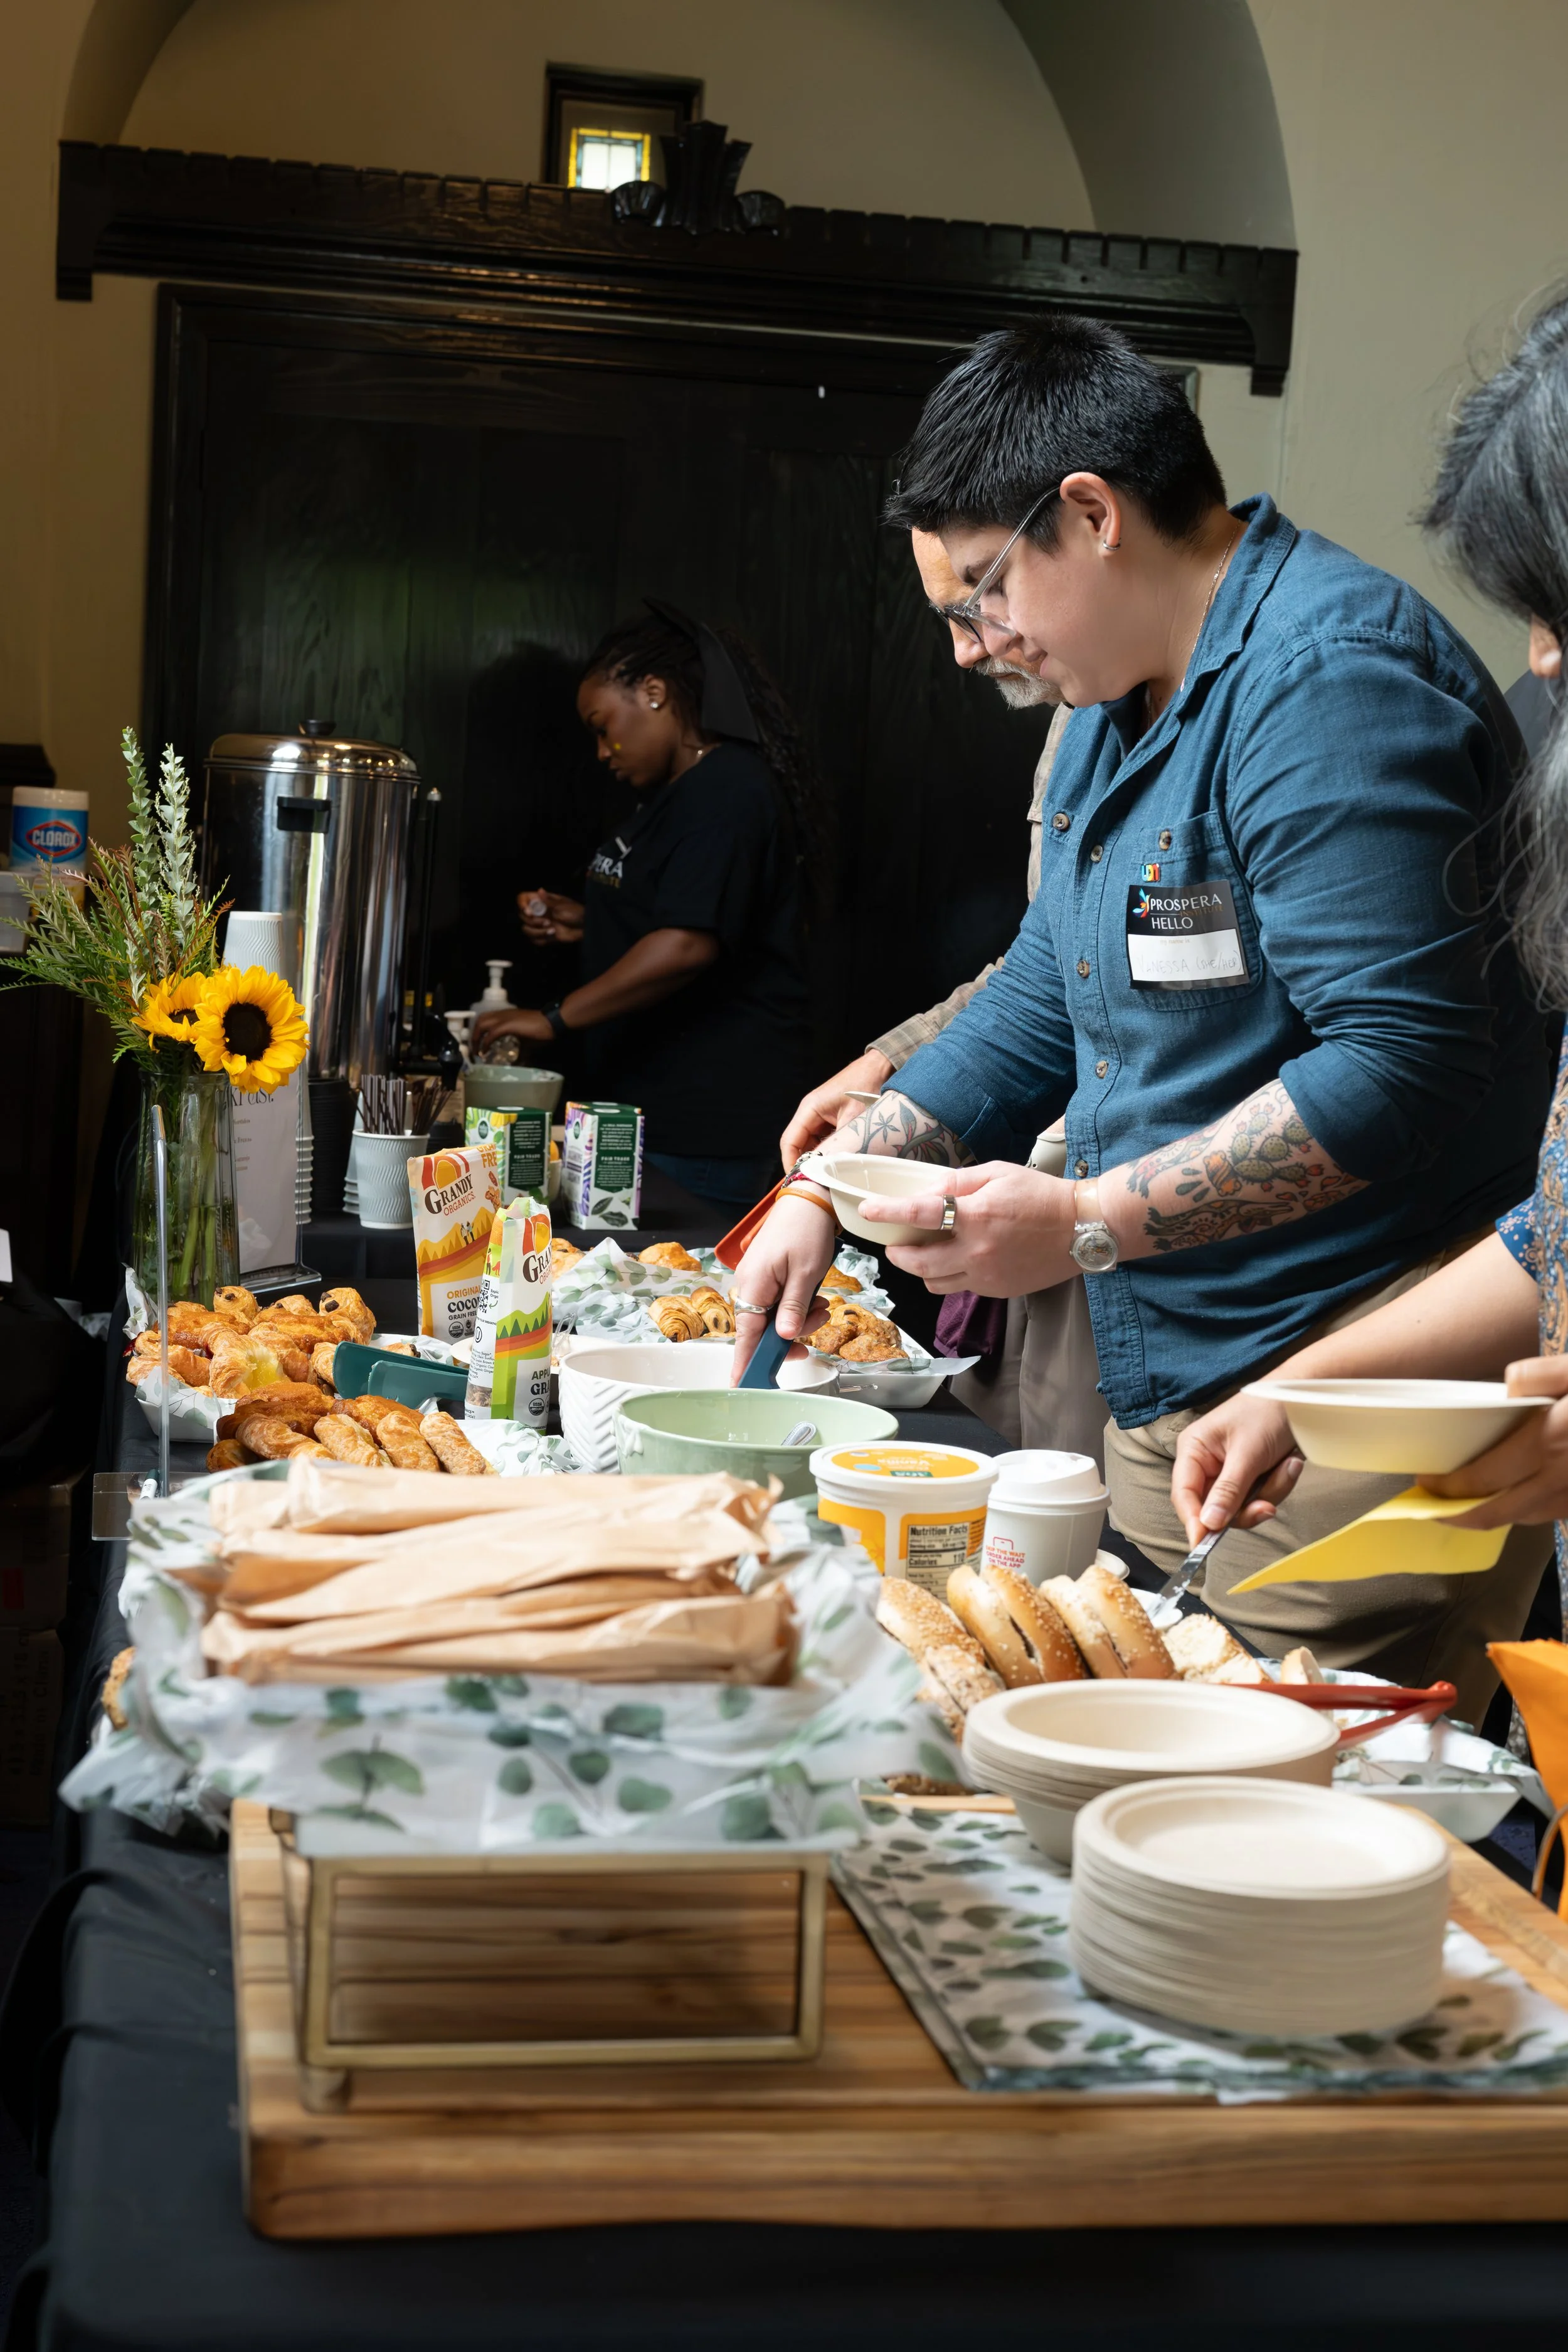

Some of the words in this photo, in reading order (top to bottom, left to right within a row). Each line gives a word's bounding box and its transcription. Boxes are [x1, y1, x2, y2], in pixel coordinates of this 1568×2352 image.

[32, 829, 76, 847] CLOROX
[1150, 893, 1222, 911] PROSPERA
[1152, 917, 1193, 930] HELLO
[1137, 953, 1190, 974] VANESSA
[481, 1151, 497, 1168] FRE
[425, 1174, 474, 1214] GRANDY
[443, 1191, 475, 1216] ORGANICS
[448, 1312, 467, 1320] GRAIN
[531, 1367, 550, 1380] APPL
[531, 1380, 550, 1396] GRA
[910, 1527, 946, 1536] Nutrition
[949, 1525, 968, 1534] Facts
